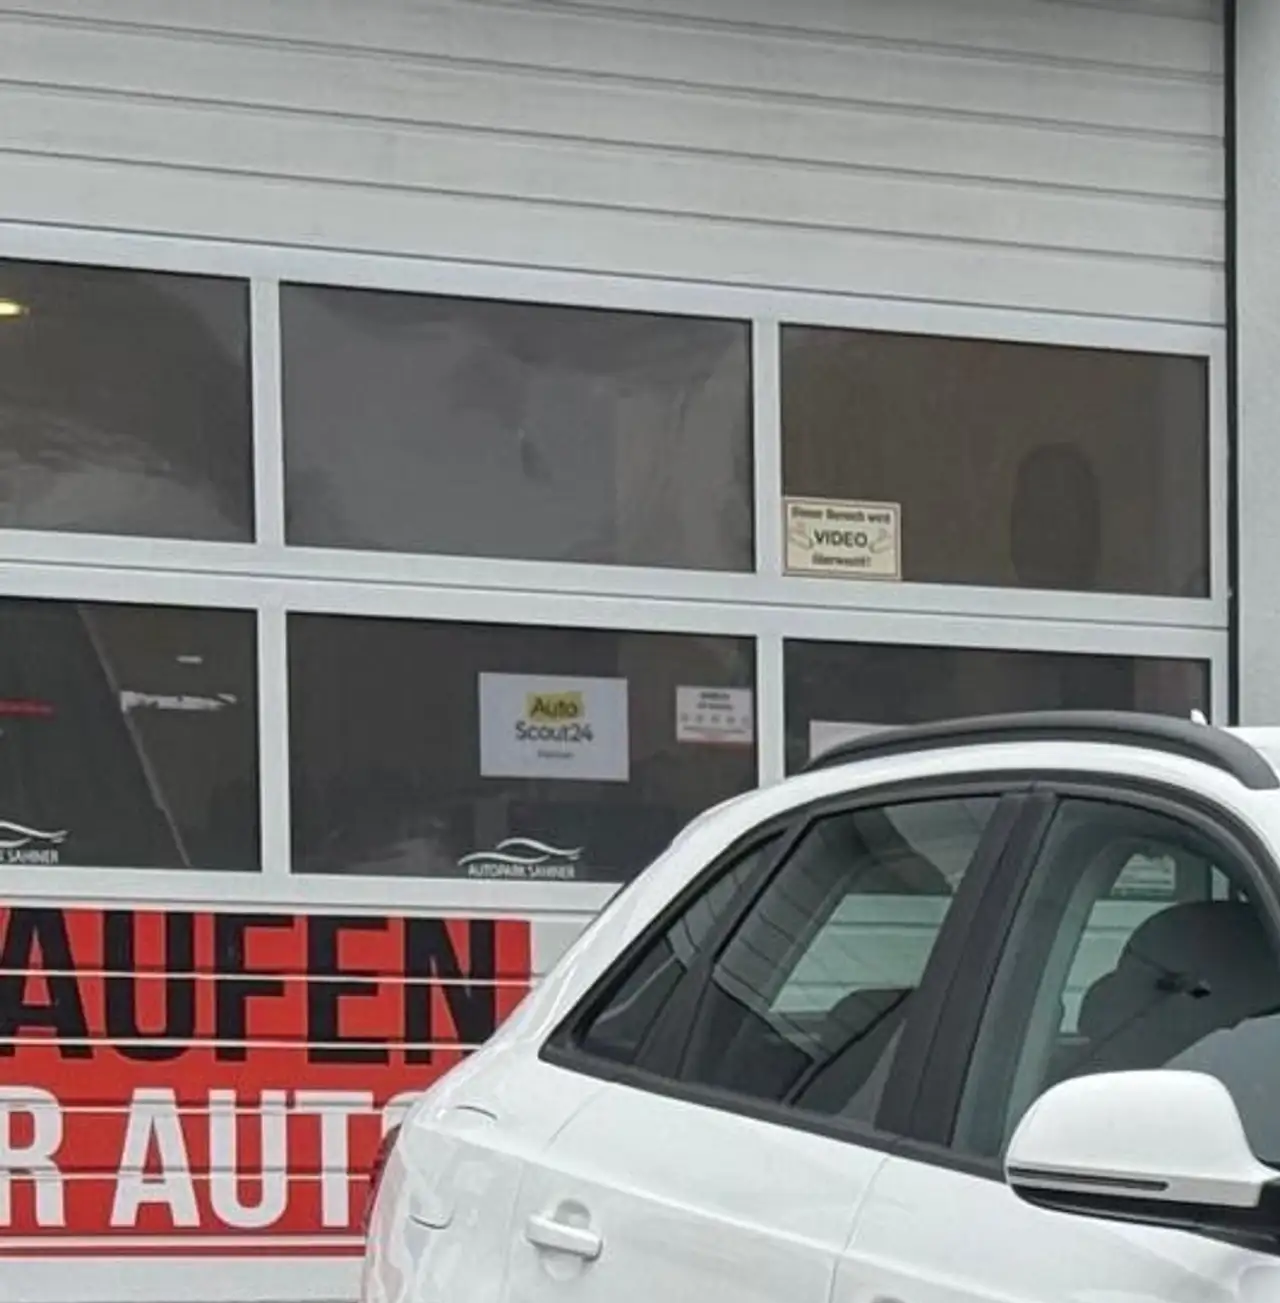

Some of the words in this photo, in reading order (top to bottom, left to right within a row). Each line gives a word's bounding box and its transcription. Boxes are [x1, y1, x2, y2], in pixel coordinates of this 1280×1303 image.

[813, 528, 868, 549] VIDEO
[529, 698, 579, 720] Auto
[515, 721, 593, 743] Scout24
[0, 907, 497, 1065] AUFEN
[109, 1087, 425, 1229] AUT
